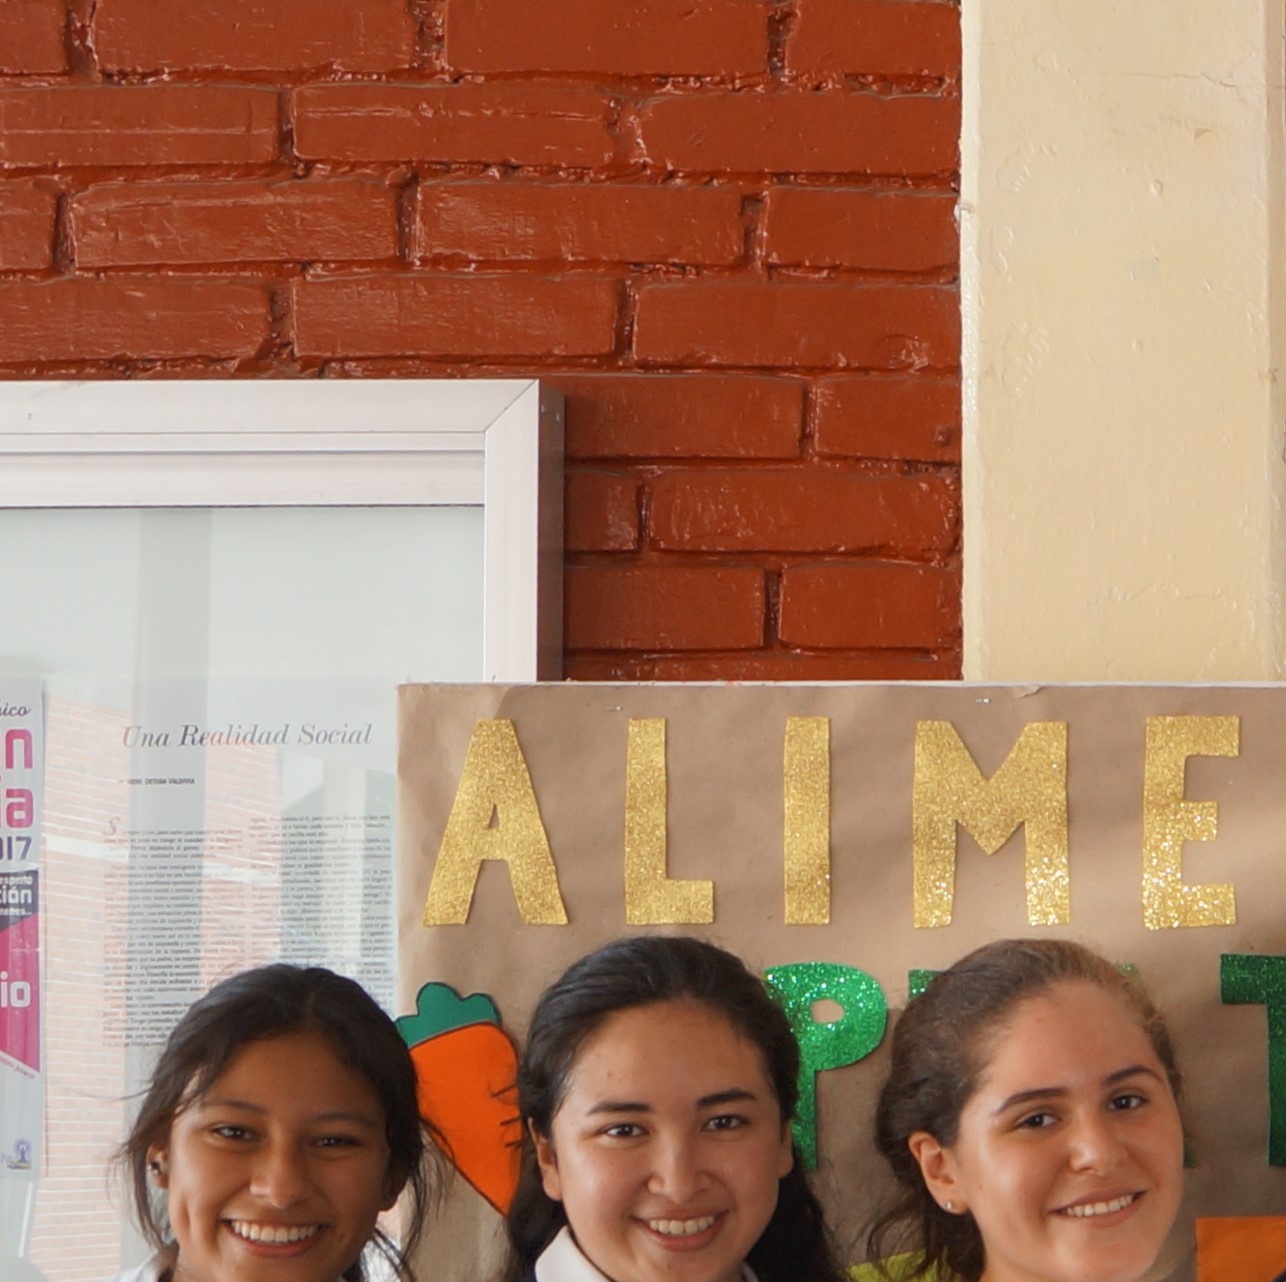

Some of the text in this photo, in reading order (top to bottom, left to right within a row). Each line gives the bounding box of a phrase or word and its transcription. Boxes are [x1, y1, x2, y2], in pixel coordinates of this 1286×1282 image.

[122, 723, 373, 748] Una Realidad Social
